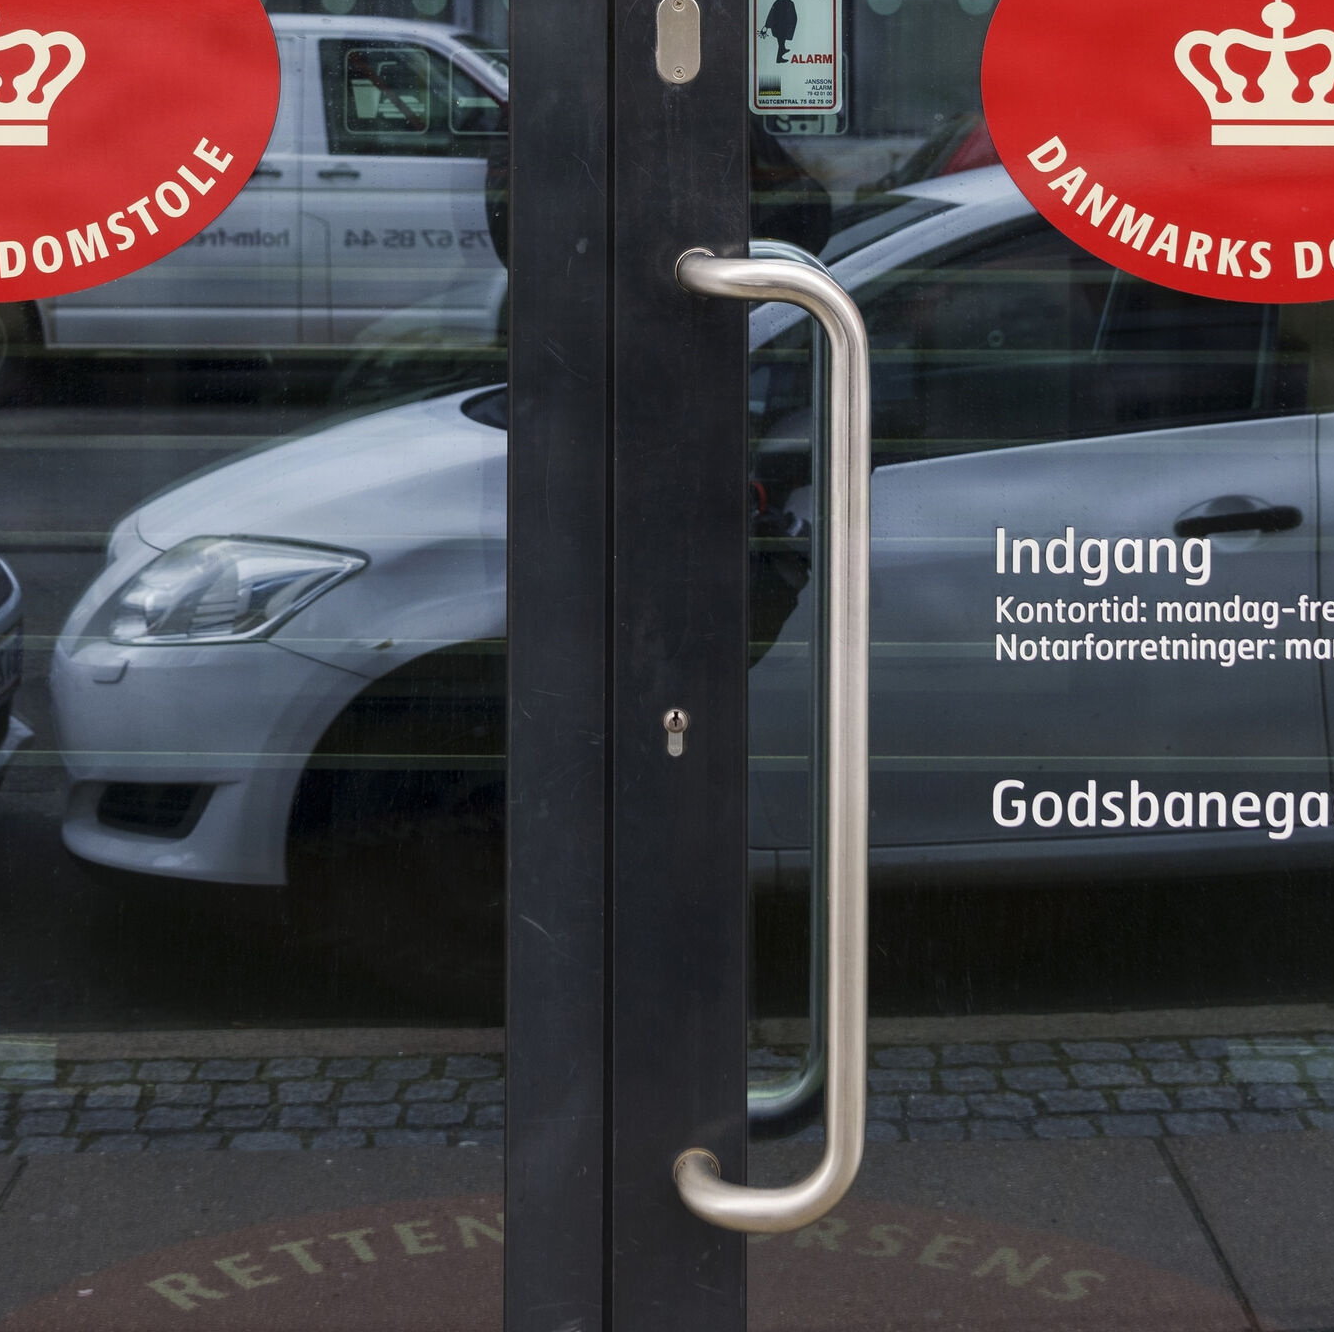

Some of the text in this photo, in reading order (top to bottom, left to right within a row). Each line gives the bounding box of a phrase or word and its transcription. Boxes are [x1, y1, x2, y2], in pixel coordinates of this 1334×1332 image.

[790, 54, 832, 64] ALARM
[1026, 135, 1272, 280] DANMARKS
[996, 526, 1211, 587] Indgang
[996, 594, 1148, 623] Kontortid:
[995, 632, 1276, 667] Notarforretninger:
[146, 1212, 1107, 1311] RETTEN RSENS
